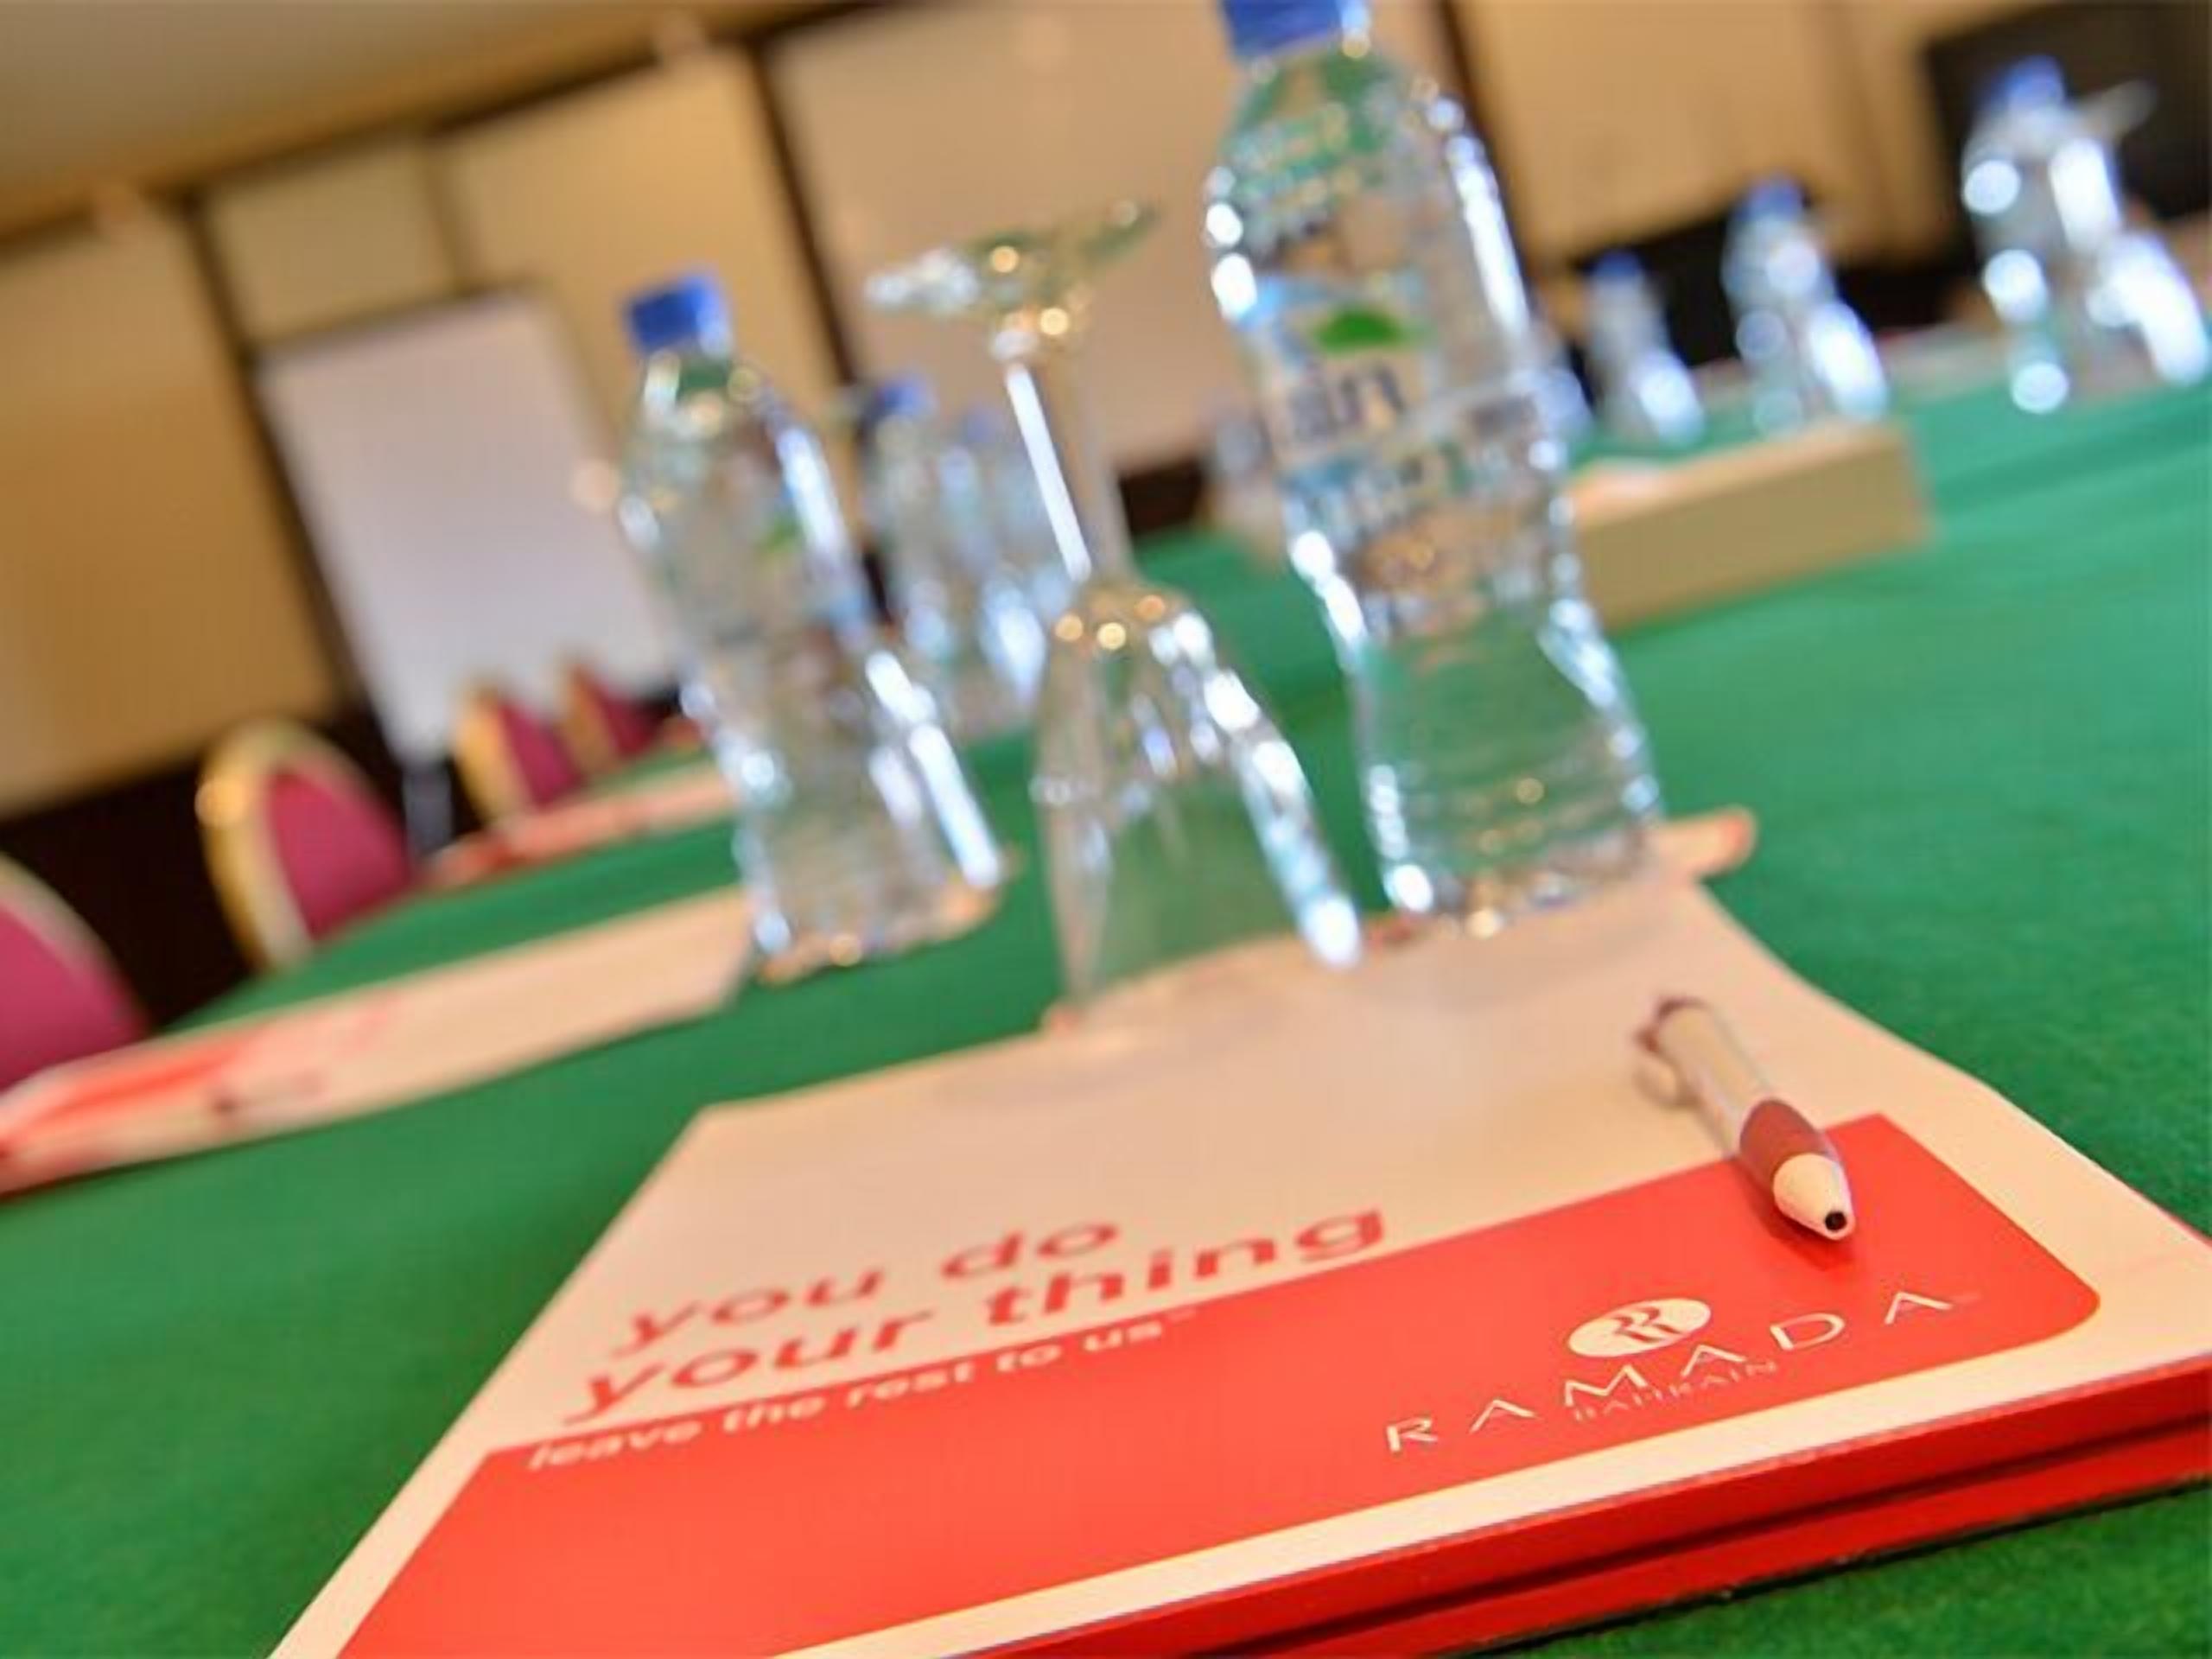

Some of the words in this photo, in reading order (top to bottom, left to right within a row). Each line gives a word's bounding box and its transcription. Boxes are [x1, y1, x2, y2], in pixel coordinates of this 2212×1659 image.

[560, 1306, 938, 1427] your
[983, 1208, 1384, 1329] thing
[610, 1267, 885, 1360] you
[938, 1222, 1120, 1281] do
[527, 1419, 703, 1472] leave
[721, 1393, 827, 1434] the
[844, 1360, 975, 1412] rest
[995, 1341, 1064, 1374] to
[1384, 1290, 1955, 1453] RAMADA
